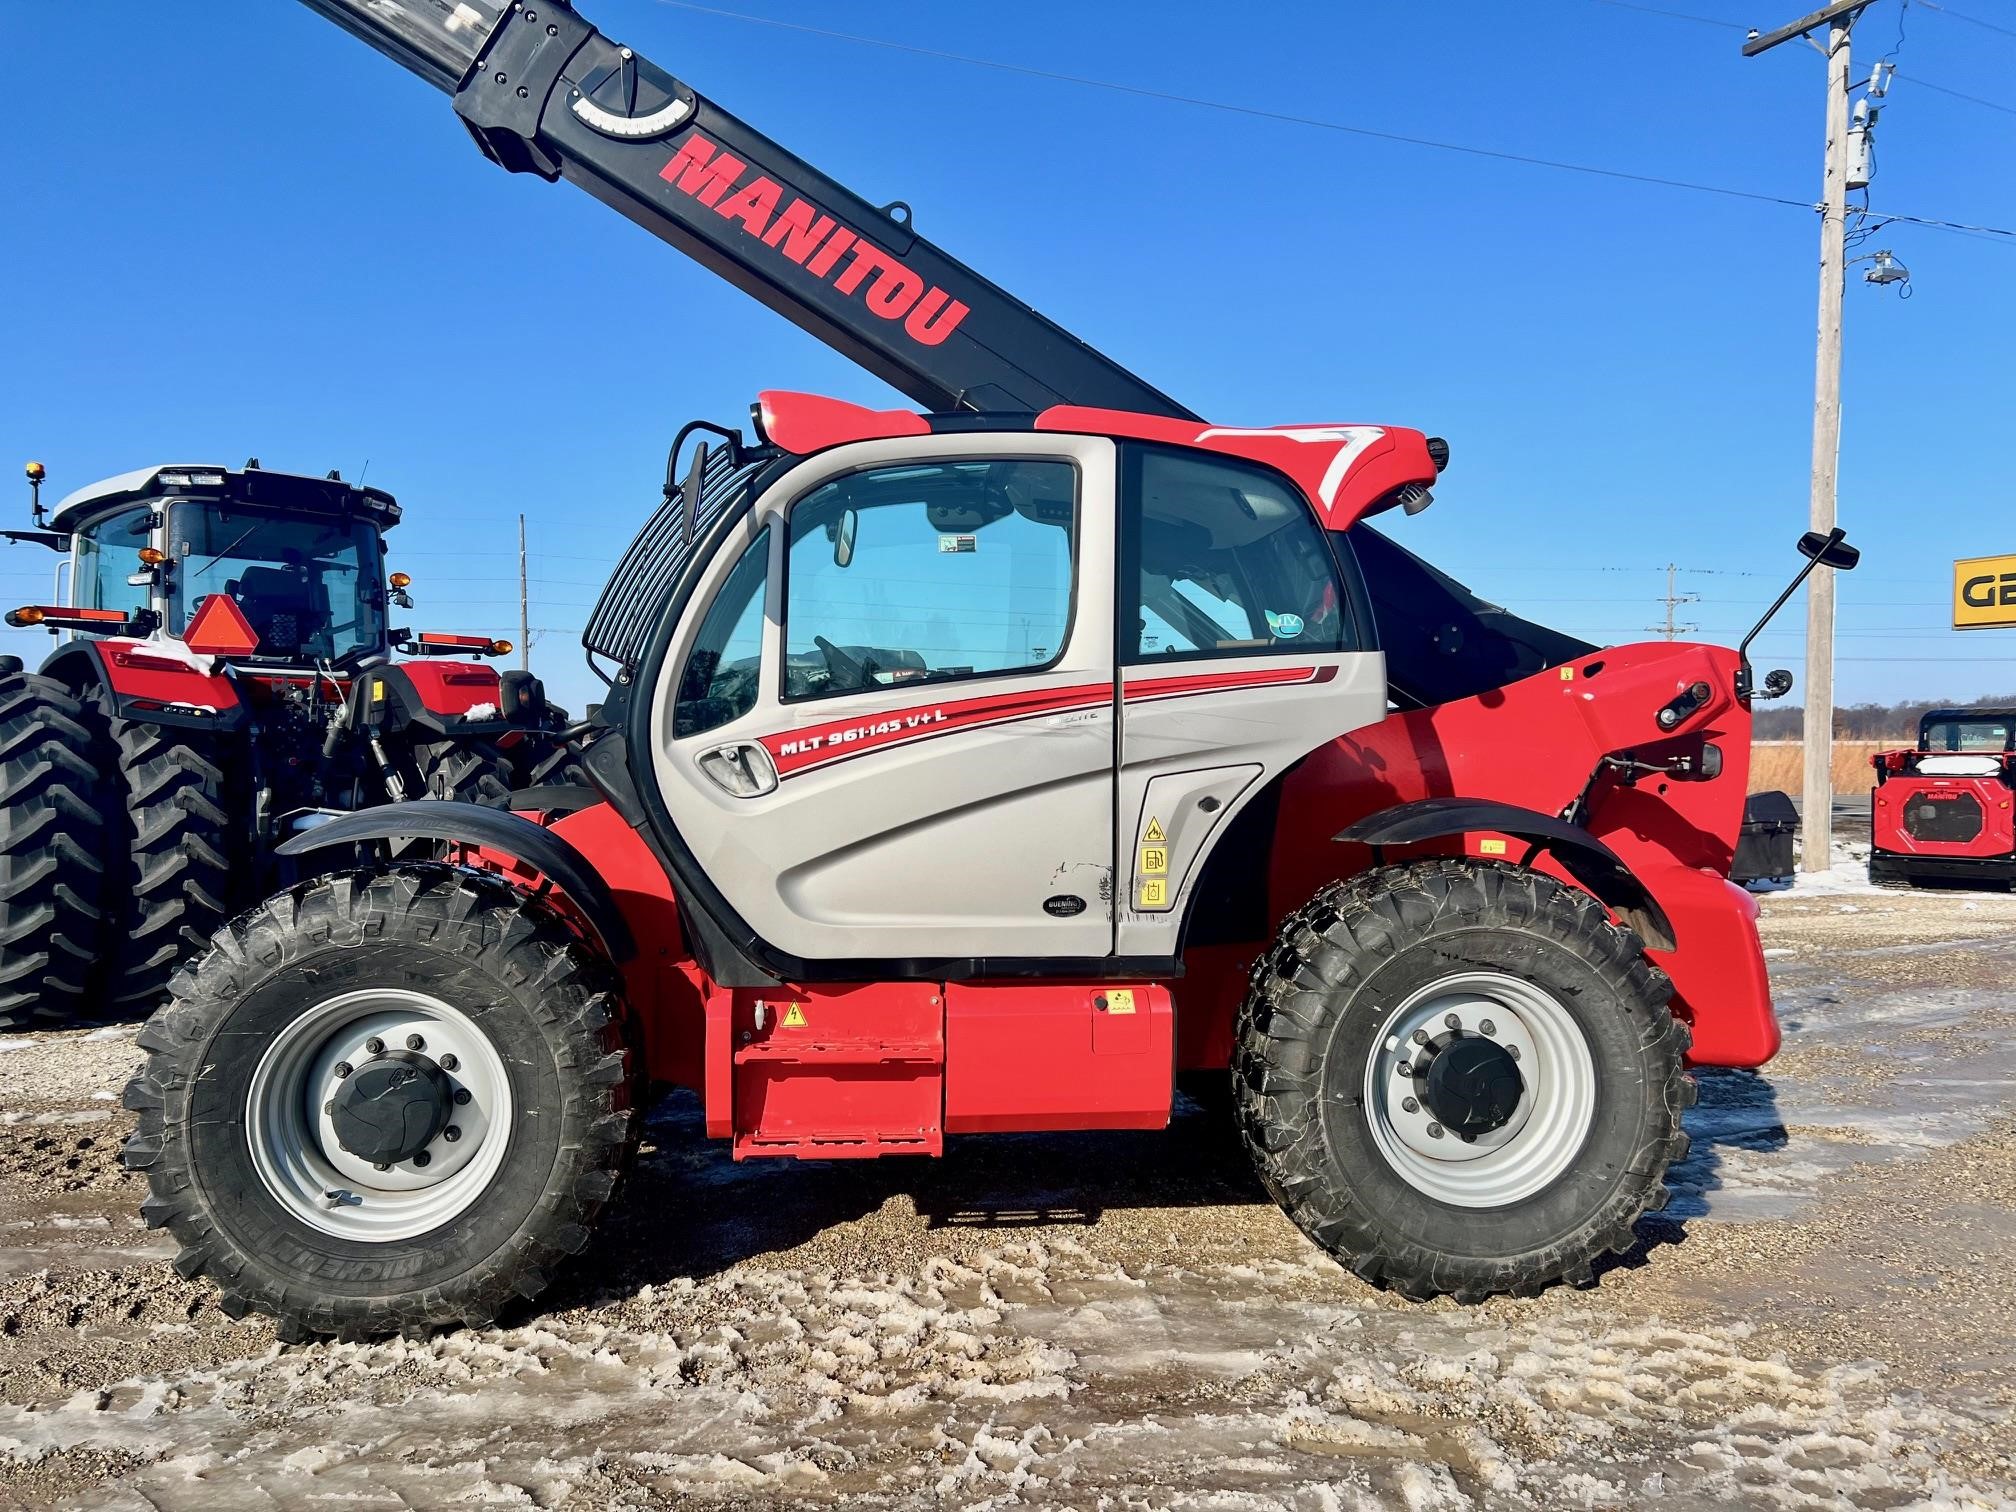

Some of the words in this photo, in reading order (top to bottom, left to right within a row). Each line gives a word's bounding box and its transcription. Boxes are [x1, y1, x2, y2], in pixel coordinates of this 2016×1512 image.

[658, 133, 970, 345] MANITOU
[780, 736, 823, 756] MLT
[935, 709, 947, 722] L
